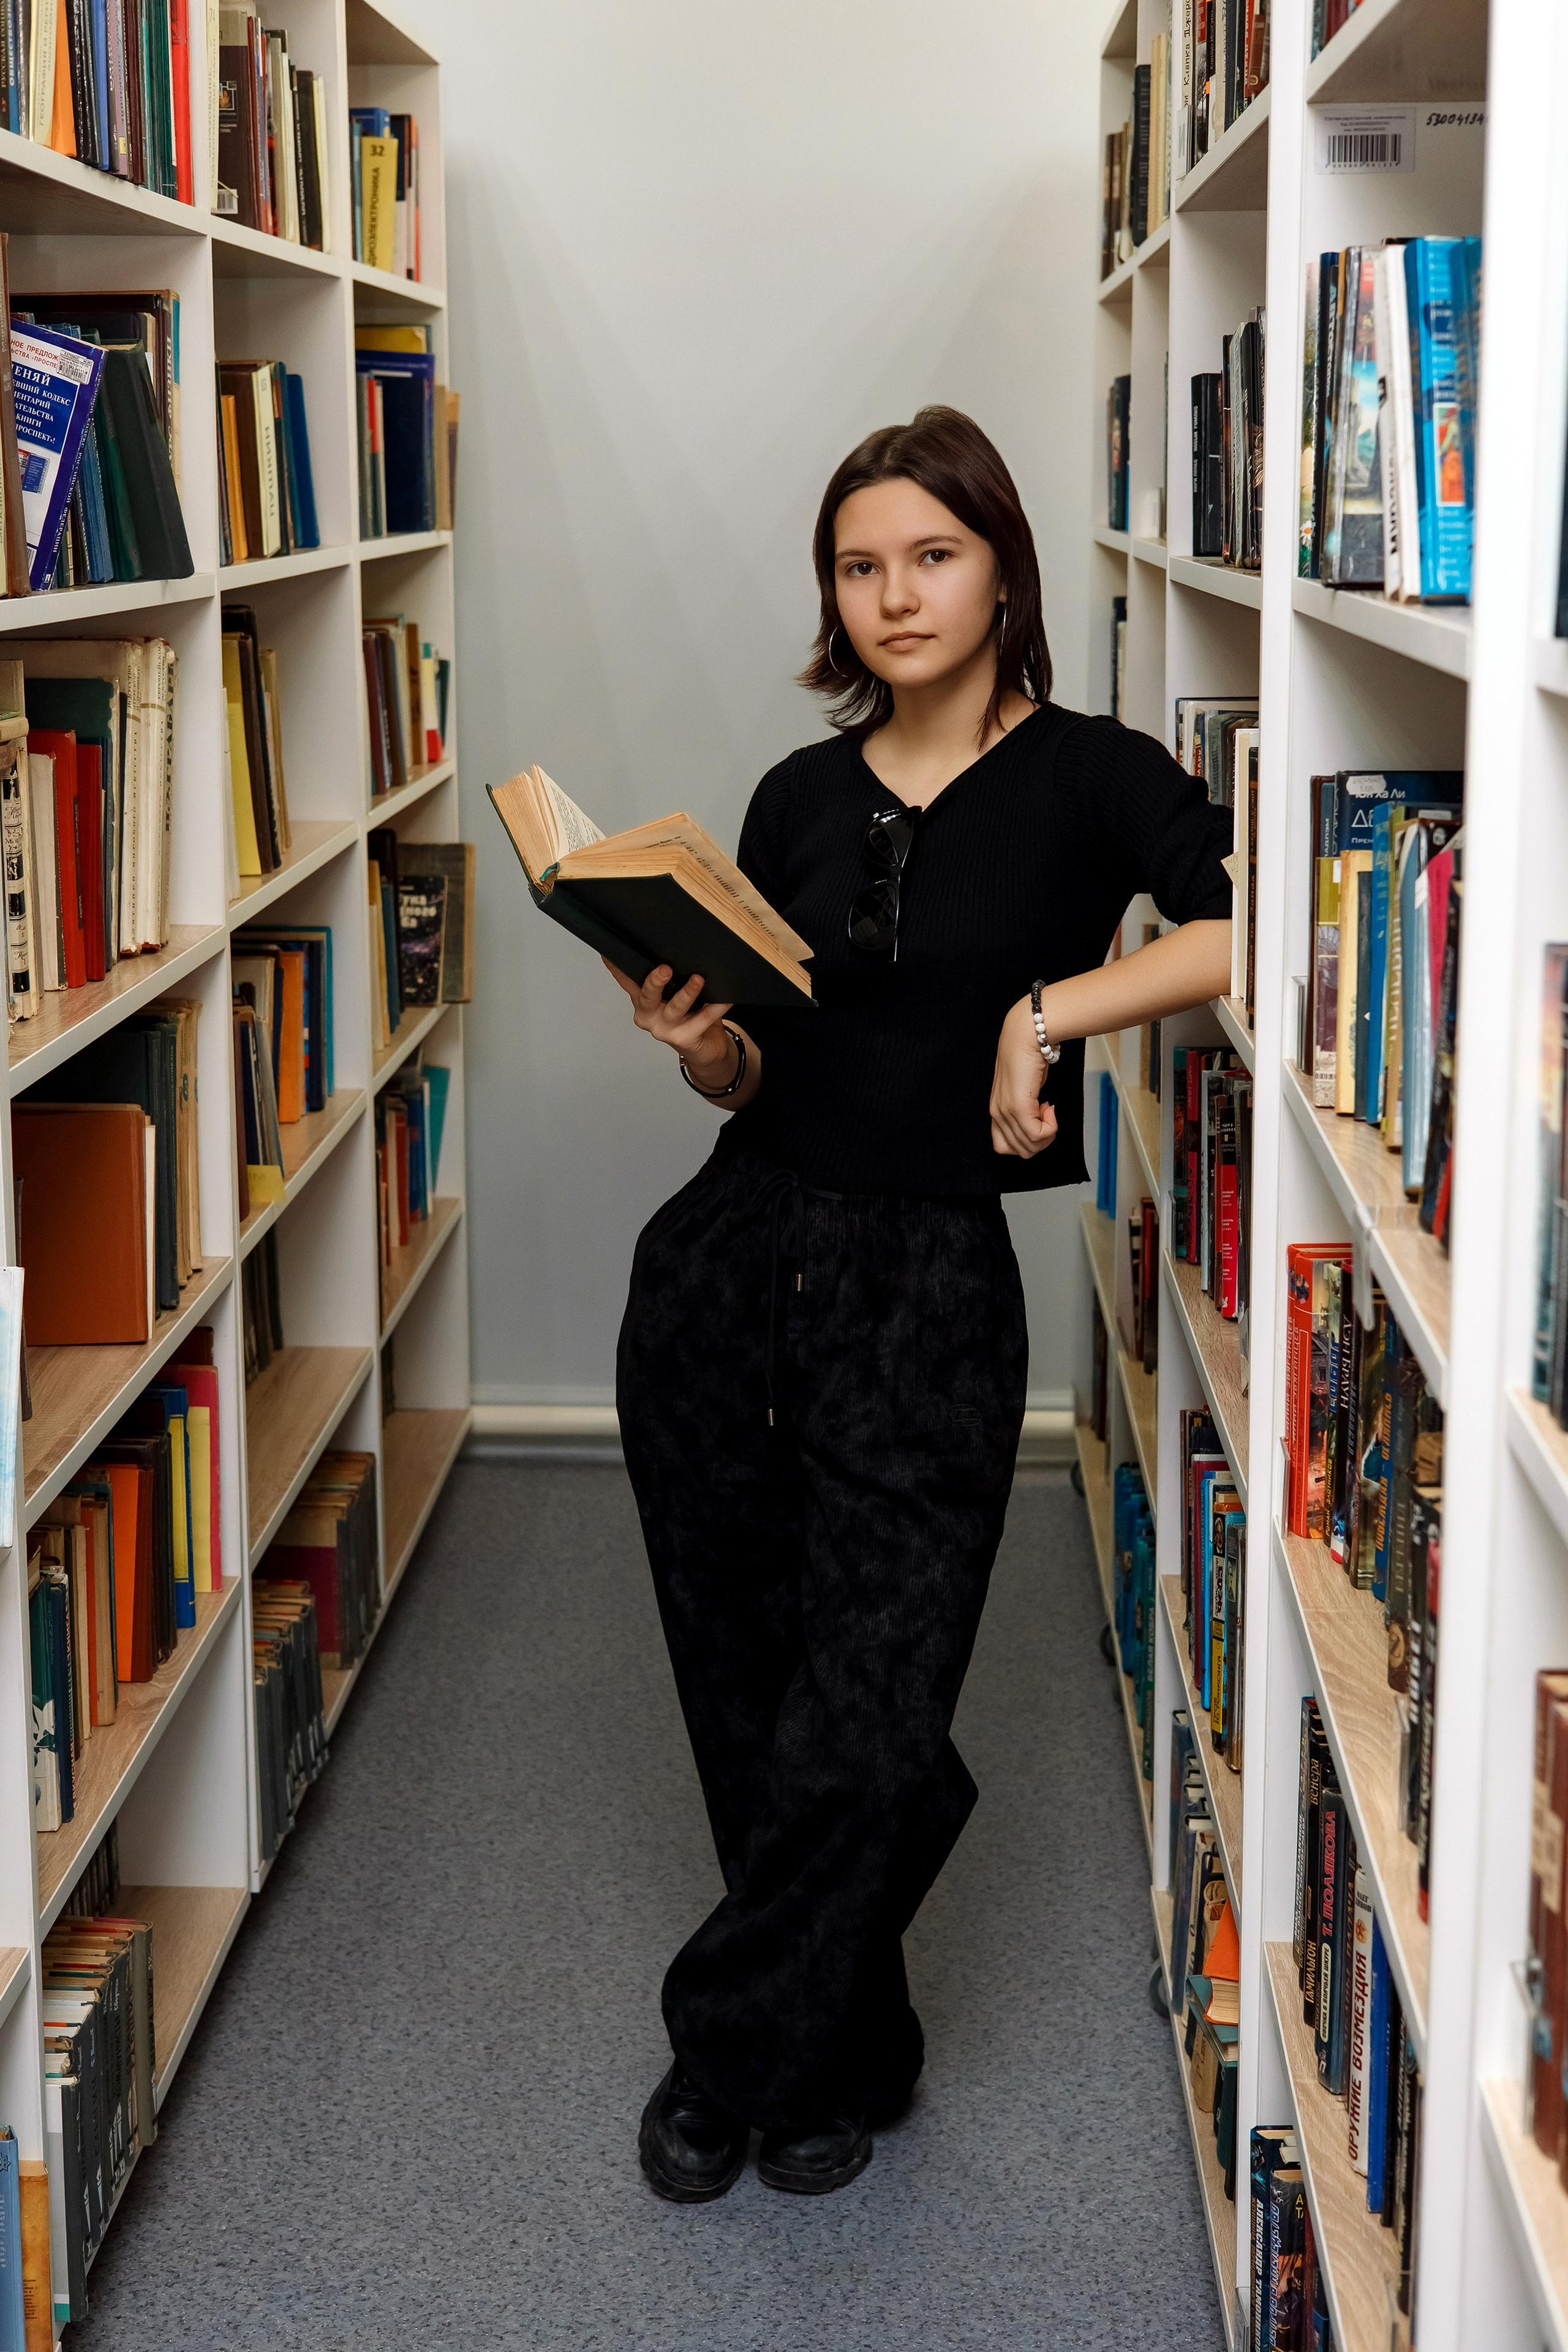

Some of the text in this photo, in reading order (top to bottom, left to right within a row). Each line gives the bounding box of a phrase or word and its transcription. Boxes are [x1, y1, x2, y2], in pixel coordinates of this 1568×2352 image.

[16, 413, 42, 428] КНИГИ
[42, 390, 72, 407] КОДЕКС
[81, 417, 91, 449] КОДЕКС
[66, 451, 83, 504] РОССИЙСКОЙ
[53, 507, 69, 553] ФЕДЕРАЦИИ
[1389, 788, 1406, 799] Ли
[1341, 1314, 1352, 1409] ДЭН БРАУН
[1322, 1811, 1336, 1937] Т. ПОЛЯКОВА
[1305, 1939, 1317, 2004] ГАМИЛЬТОН
[1348, 1950, 1369, 2162] ОРУЖИЕ ВОЗМЕЗДИЯ
[1254, 2199, 1264, 2352] АЛЕКСАНДР ТАМОНИКОВ
